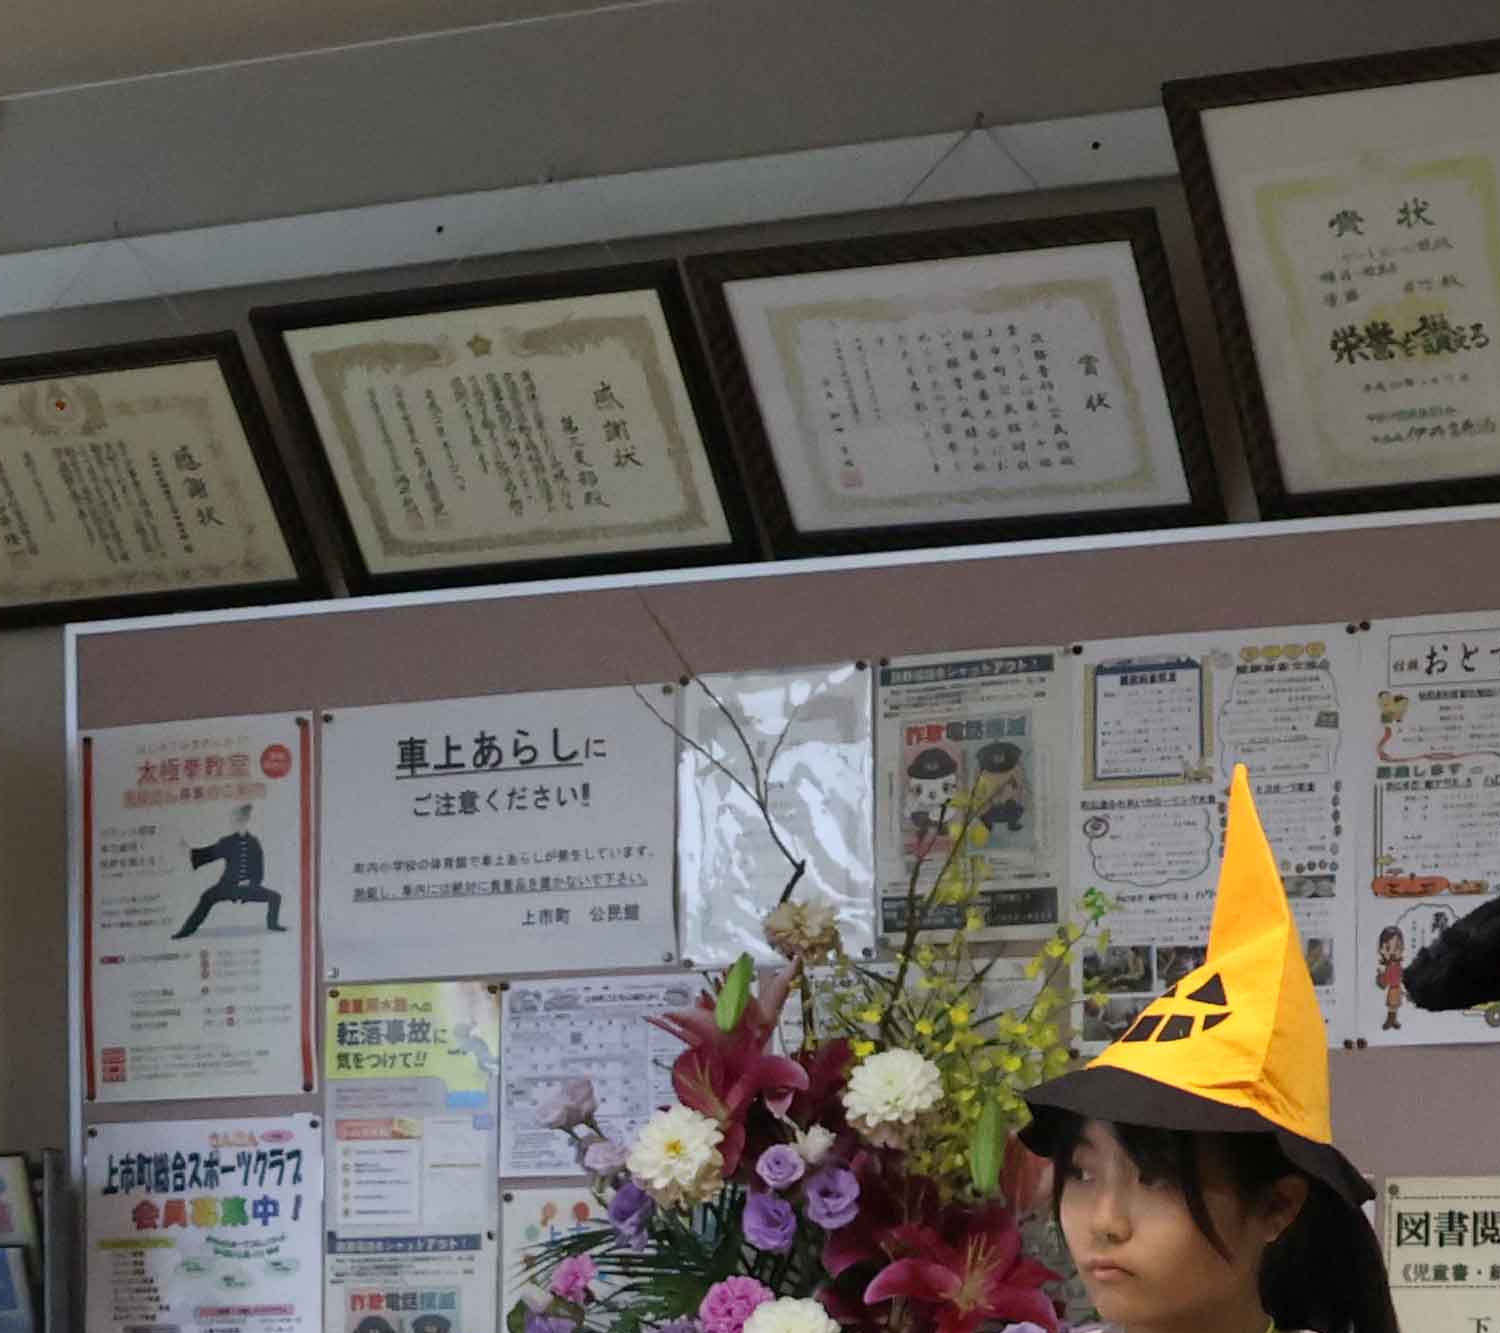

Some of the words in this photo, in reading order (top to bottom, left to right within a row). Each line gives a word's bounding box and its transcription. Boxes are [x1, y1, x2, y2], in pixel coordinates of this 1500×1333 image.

[396, 727, 608, 776] 車上あらしに
